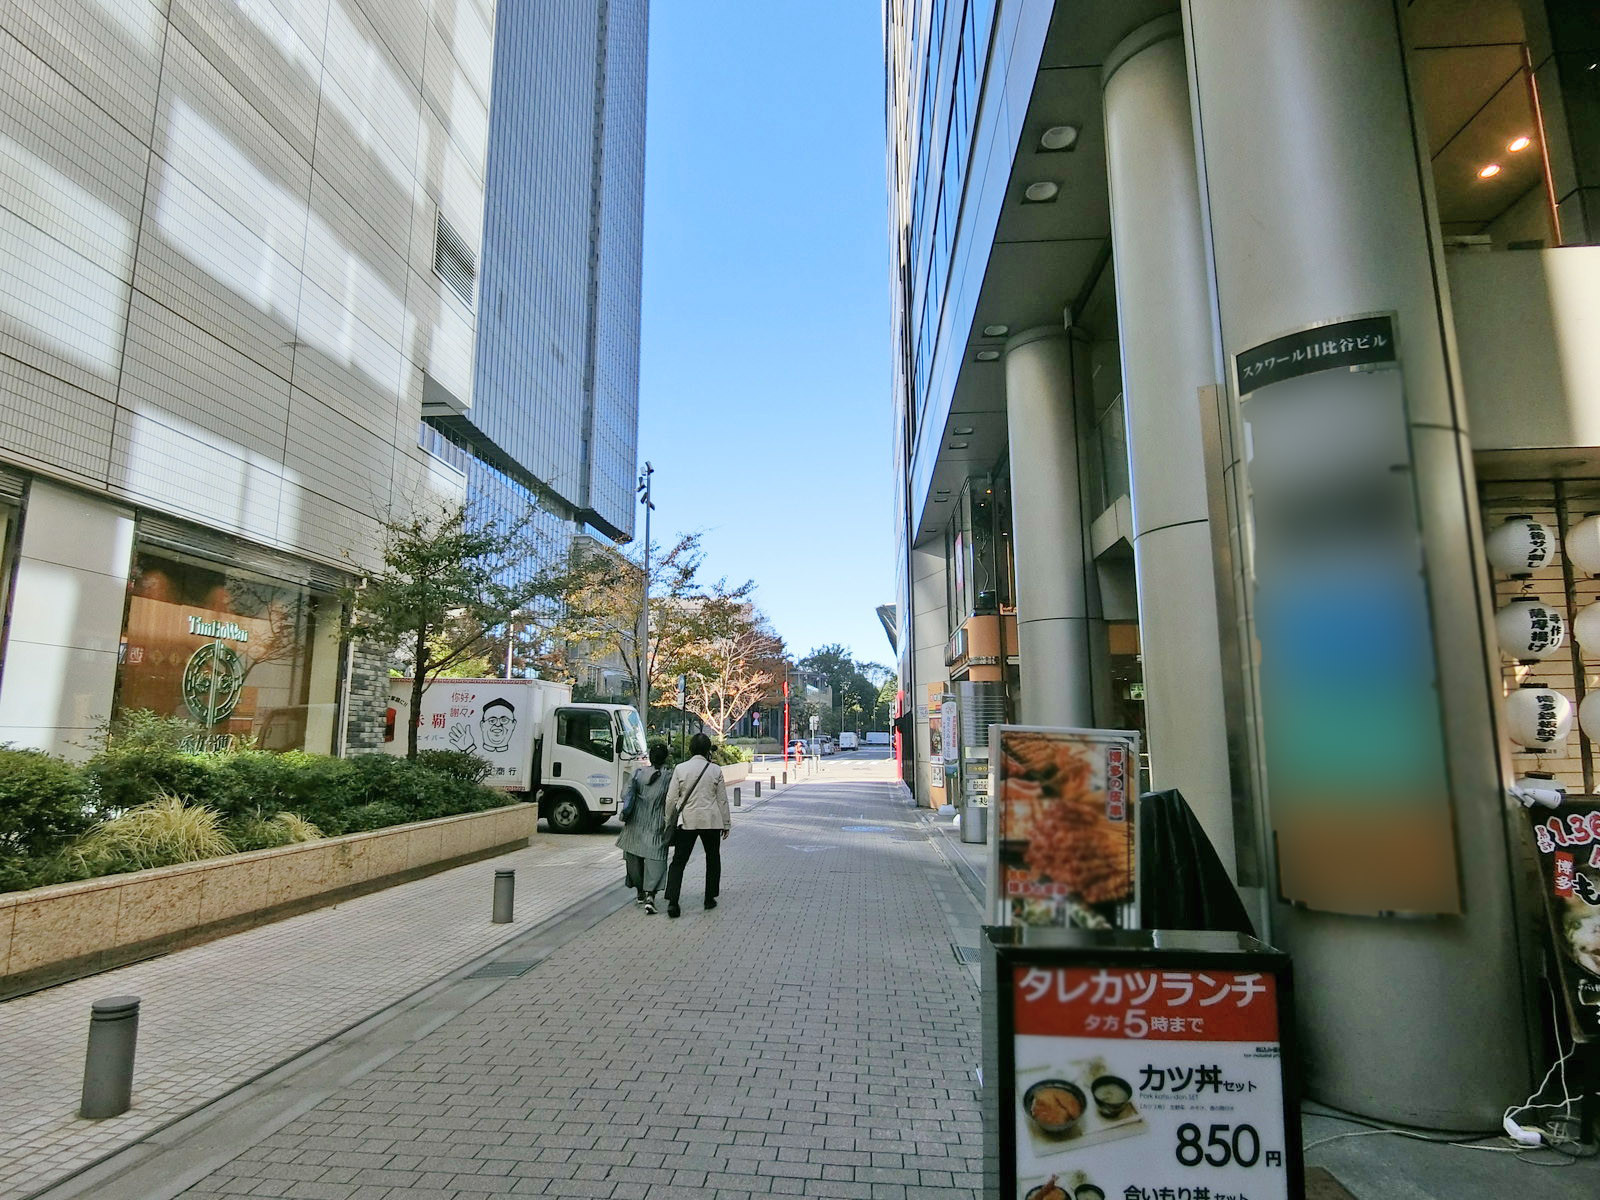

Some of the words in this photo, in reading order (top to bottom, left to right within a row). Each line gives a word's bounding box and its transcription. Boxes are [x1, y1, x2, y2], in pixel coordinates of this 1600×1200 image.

[1242, 334, 1388, 379] スクワール日比谷ビル
[1556, 859, 1573, 890] 博多
[1019, 967, 1266, 1008] タレカツランチ
[1084, 1009, 1204, 1038] 夕方5時まで
